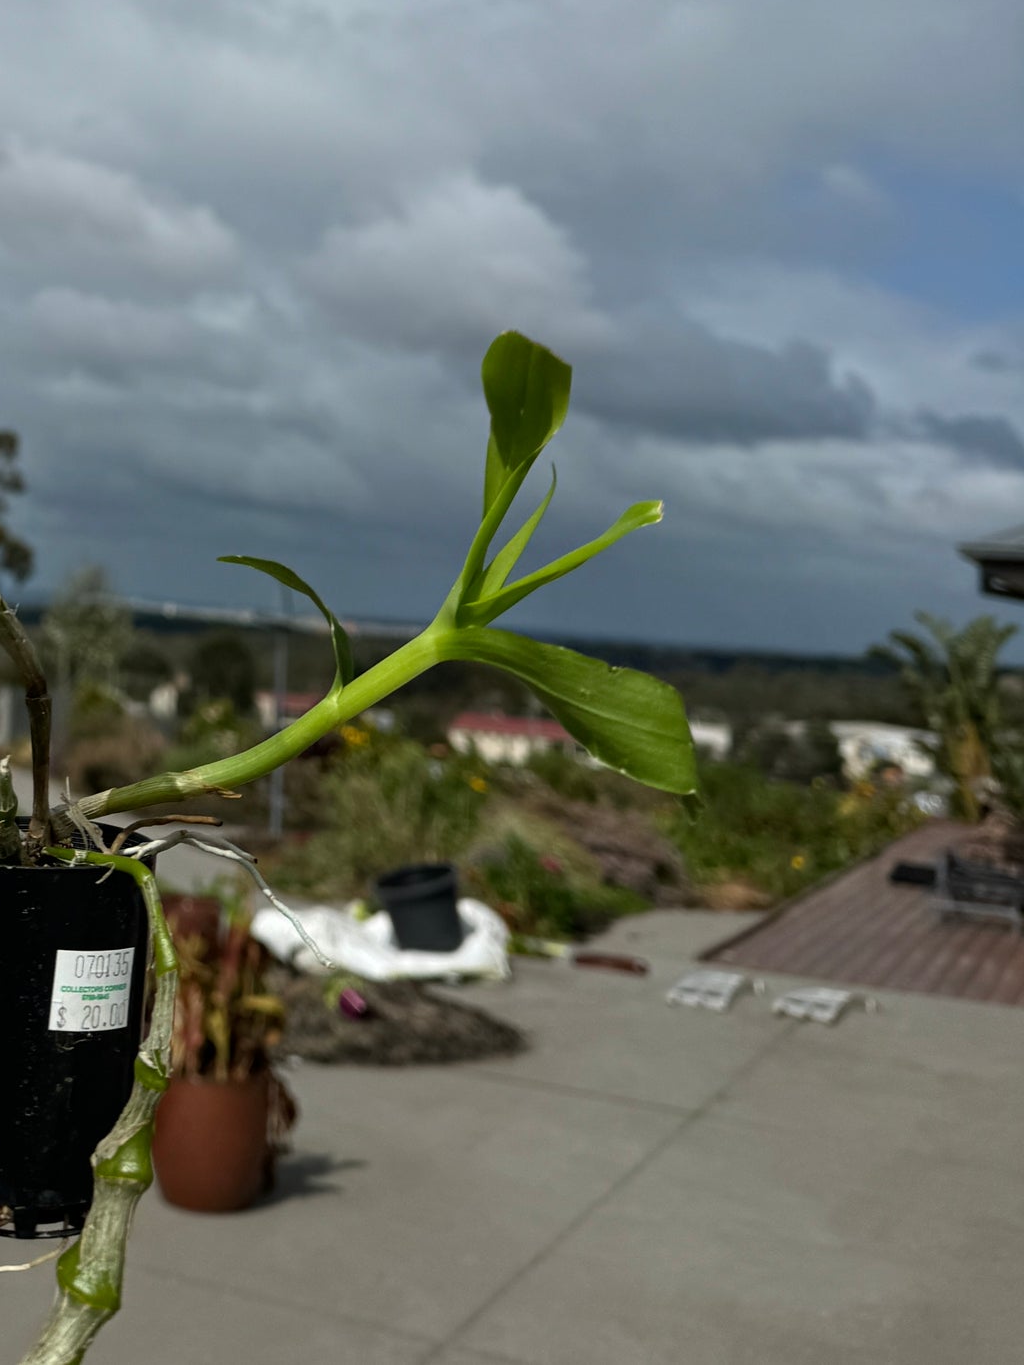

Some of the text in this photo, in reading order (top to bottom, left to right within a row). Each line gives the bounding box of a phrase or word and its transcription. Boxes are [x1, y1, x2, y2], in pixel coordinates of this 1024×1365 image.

[74, 951, 130, 978] 070135
[56, 1002, 125, 1030] $ 20.00
